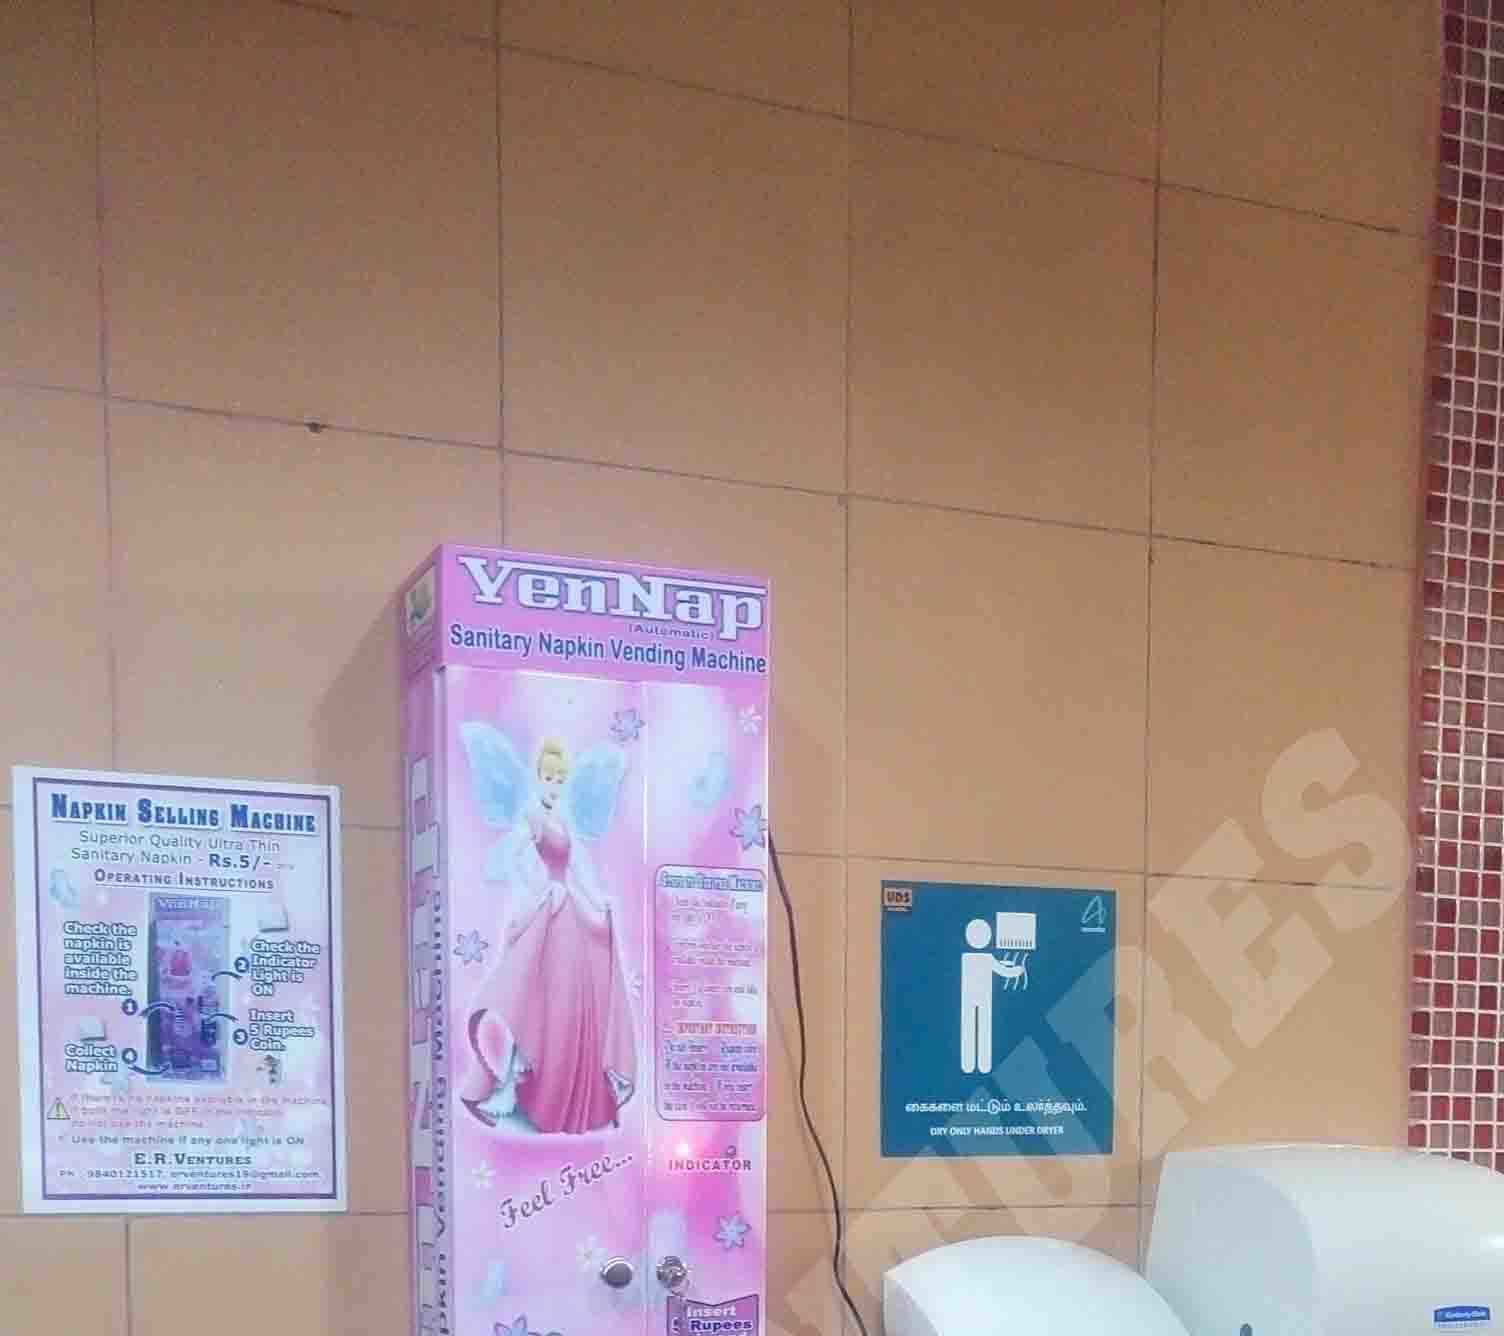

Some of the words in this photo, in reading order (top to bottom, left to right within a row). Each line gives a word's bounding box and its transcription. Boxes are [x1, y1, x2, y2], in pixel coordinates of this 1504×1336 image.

[450, 623, 532, 657] Sanitary
[539, 632, 604, 659] Napkin
[611, 639, 686, 670] Vending
[691, 646, 767, 673] Machine
[80, 831, 144, 847] Superior
[150, 834, 202, 851] Quality
[208, 838, 243, 851] Ultra
[249, 839, 281, 854] Thin
[71, 847, 136, 865] Sanitary
[141, 851, 192, 867] Napkin
[208, 853, 273, 871] Rs.5/-
[64, 921, 109, 936] Check
[112, 922, 137, 936] the
[64, 937, 115, 951] napkin
[117, 938, 131, 951] is
[251, 939, 295, 953] Check
[296, 941, 320, 954] the
[64, 952, 131, 966] available
[251, 954, 318, 969] Indicator
[112, 967, 138, 981] the
[251, 968, 289, 983] Light
[291, 969, 304, 983] is
[250, 983, 275, 996] ON
[248, 1008, 294, 1022] Insert
[249, 1023, 259, 1036] 5
[263, 1023, 315, 1039] Rupees
[64, 1044, 116, 1058] Collect
[65, 1059, 118, 1074] Napkin
[930, 1126, 947, 1136] DRY
[949, 1126, 971, 1136] ONLY
[974, 1126, 1003, 1136] HANDS
[1005, 1126, 1035, 1135] UNDER
[1036, 1125, 1064, 1135] DRYER
[72, 1135, 95, 1145] Use
[99, 1135, 119, 1145] the
[122, 1135, 174, 1145] machine
[668, 1158, 752, 1171] INDICATOR
[499, 1180, 556, 1229] Feel
[687, 1305, 736, 1317] Insert
[689, 1319, 753, 1334] Rupees
